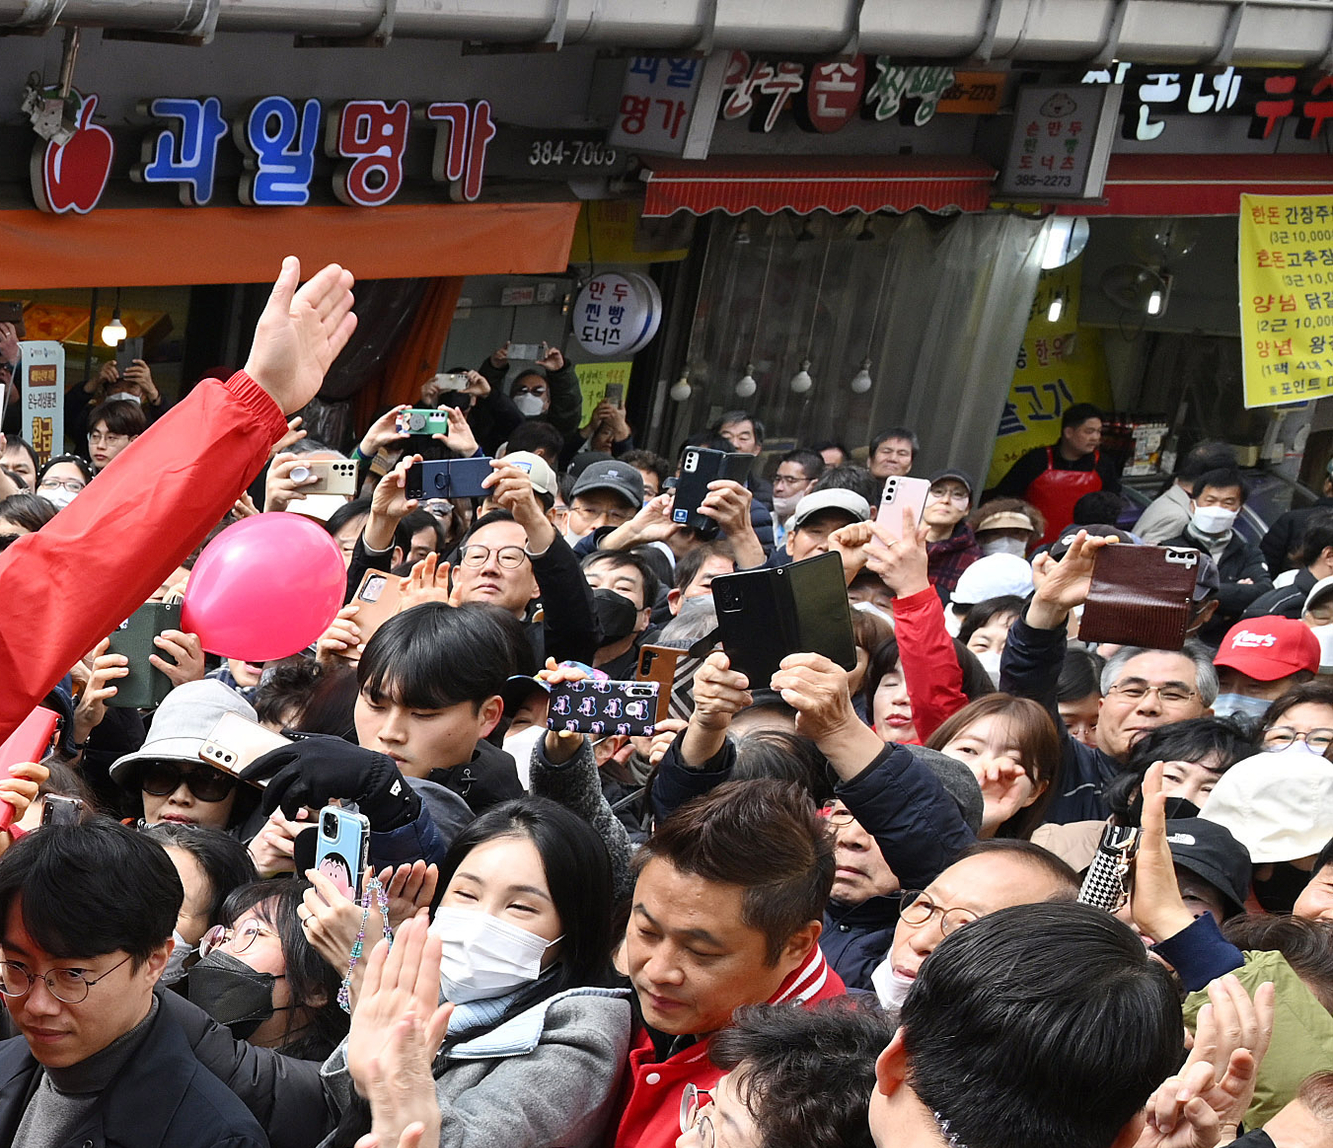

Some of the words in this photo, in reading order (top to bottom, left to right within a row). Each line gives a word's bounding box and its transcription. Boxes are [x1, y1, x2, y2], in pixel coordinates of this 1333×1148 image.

[815, 62, 857, 118] 손
[620, 95, 686, 139] 명가
[144, 96, 497, 206] 과일명가
[1015, 174, 1072, 188] 385-2273
[1251, 206, 1280, 225] 한돈
[1285, 205, 1333, 225] 간장주
[1256, 249, 1285, 268] 한돈
[589, 281, 628, 301] 만두
[1253, 293, 1297, 313] 양념
[585, 303, 625, 325] 찐빵
[581, 326, 621, 346] 도너츠
[1256, 337, 1293, 358] 양념
[1282, 378, 1321, 396] 포인트
[32, 416, 53, 453] 환급
